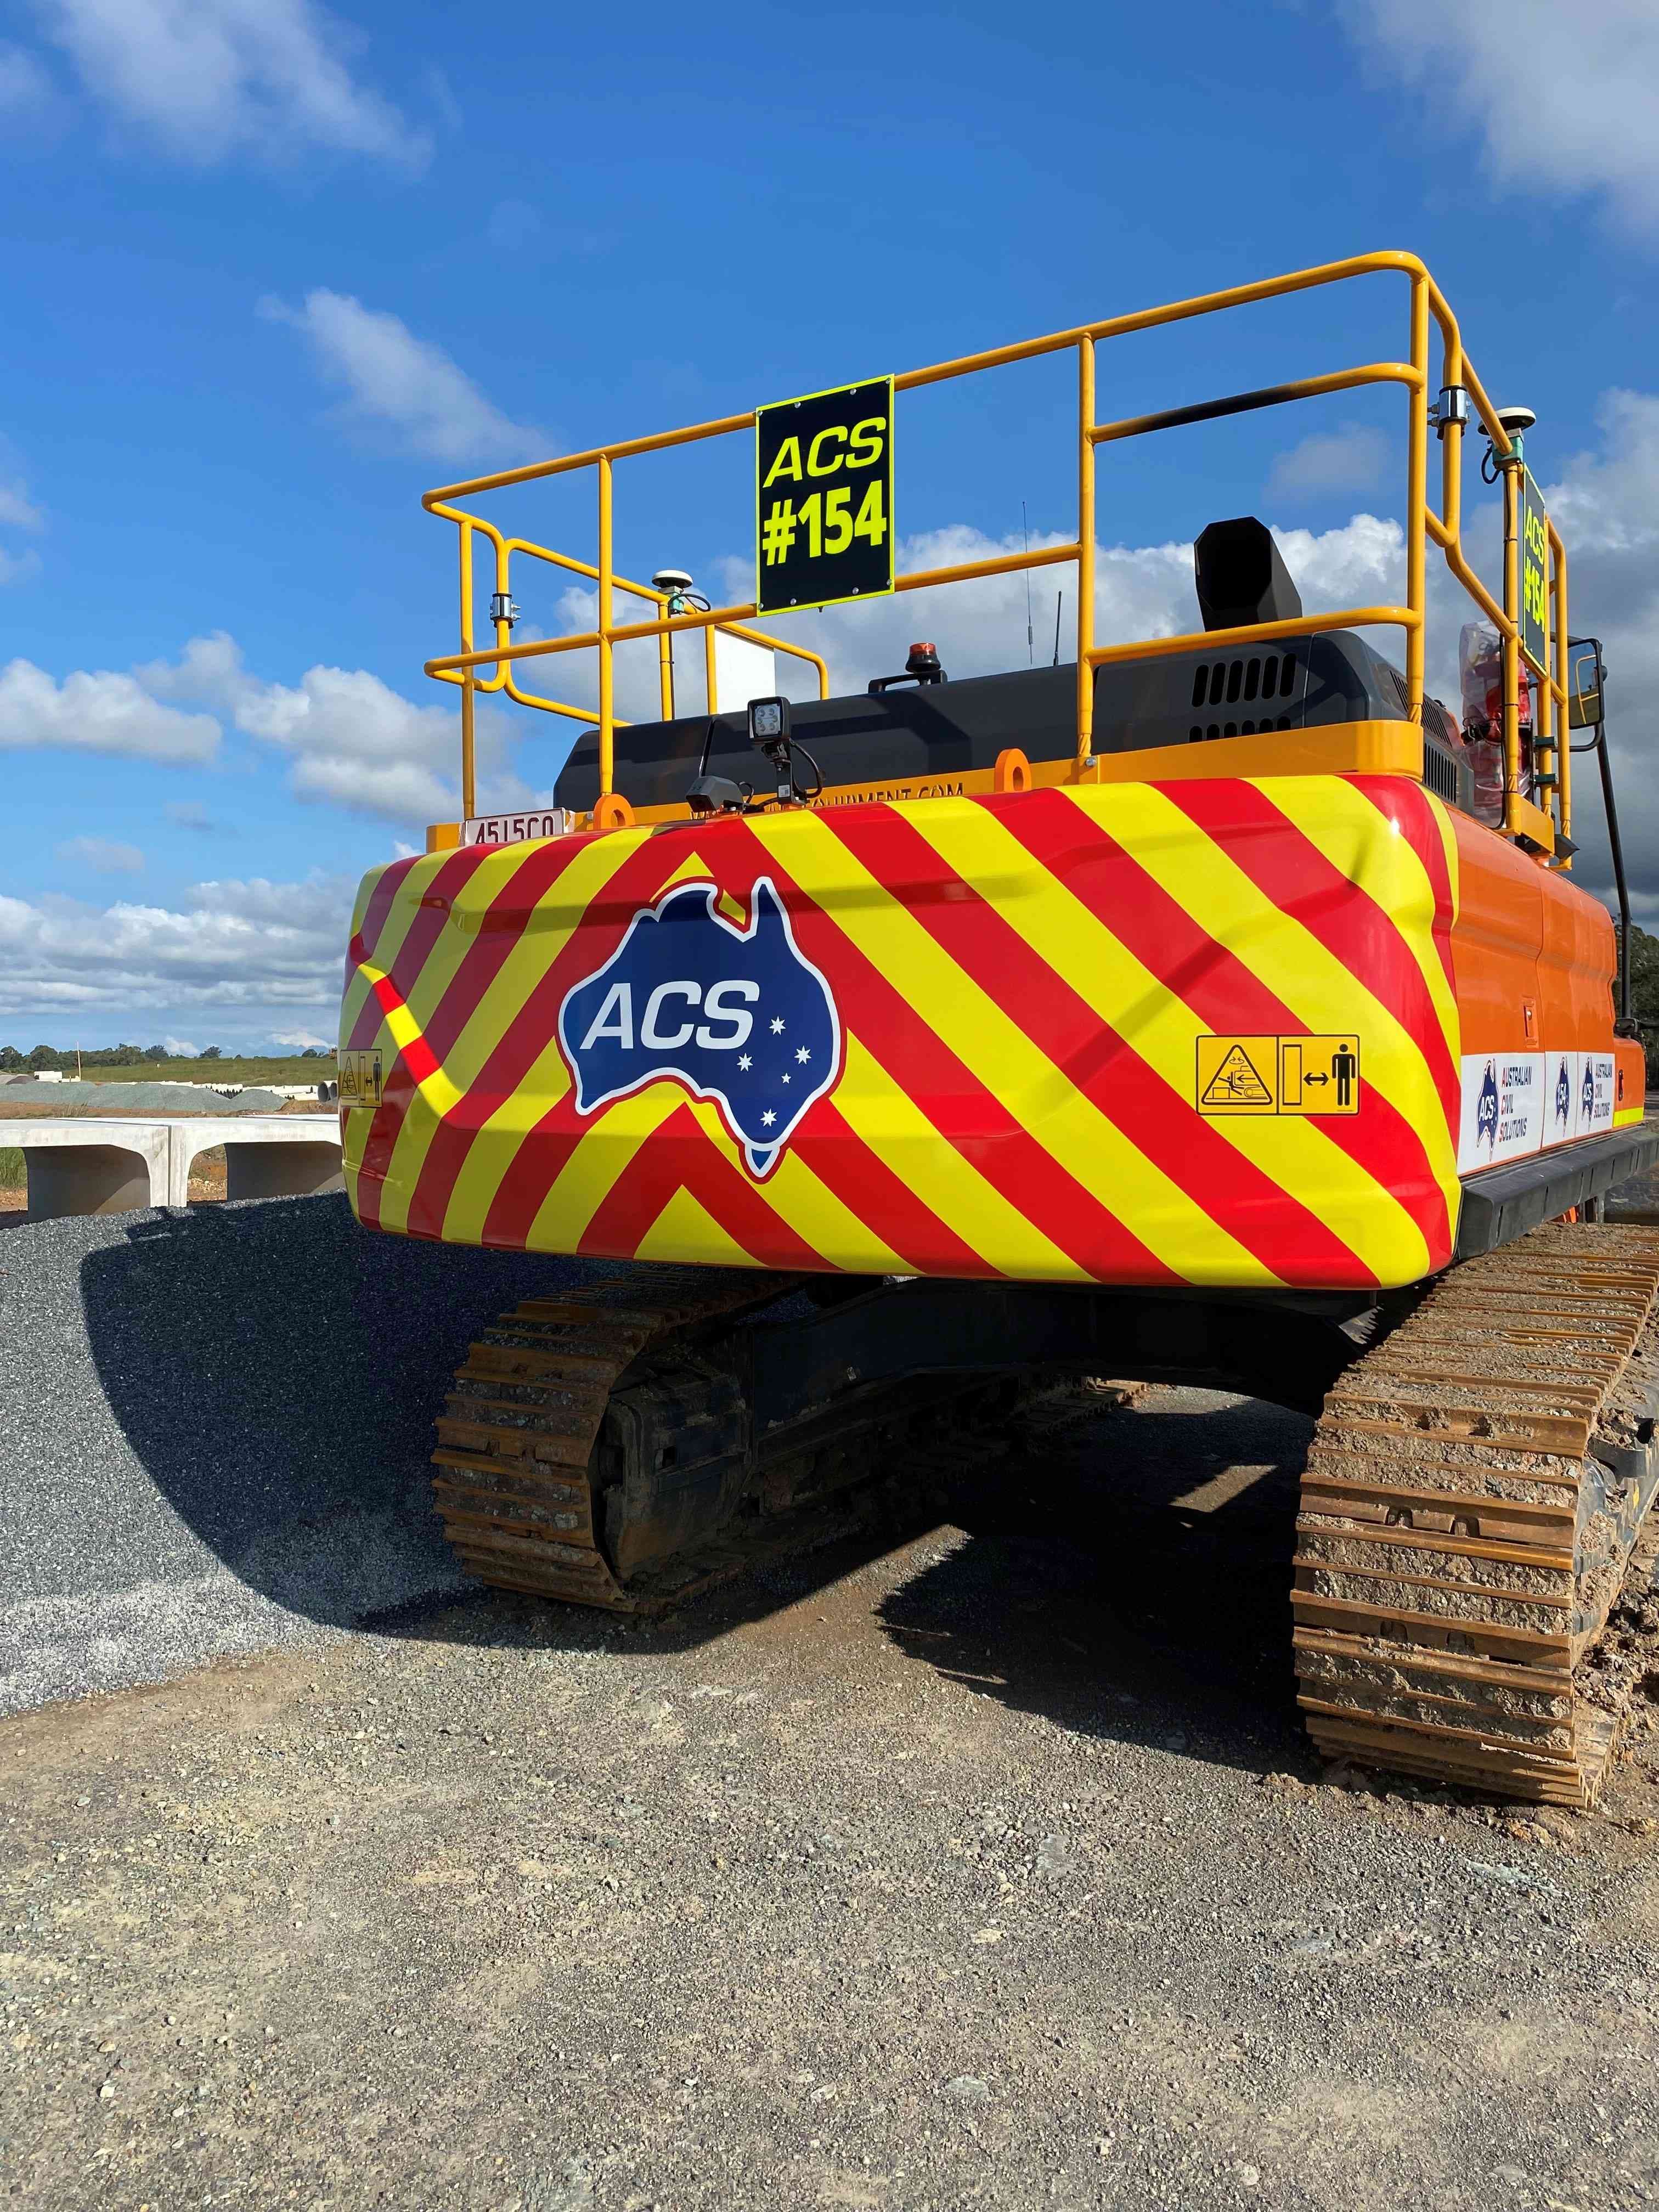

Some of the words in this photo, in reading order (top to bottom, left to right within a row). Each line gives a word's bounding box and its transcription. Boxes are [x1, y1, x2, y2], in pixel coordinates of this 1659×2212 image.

[763, 416, 886, 488] ACS
[763, 480, 887, 566] #154
[1526, 505, 1544, 565] ACS
[1525, 556, 1545, 633] #154
[579, 980, 760, 1049] ACS
[1502, 1066, 1532, 1087] AUSTRALIAN
[1595, 1064, 1612, 1078] AUSTRALIAN
[1501, 1094, 1514, 1115] CIVIL
[1583, 1083, 1592, 1102] ACS
[1479, 1095, 1494, 1121] ACS
[1594, 1102, 1610, 1119] SOLUTIONS
[1499, 1118, 1527, 1142] SOLUTIONS
